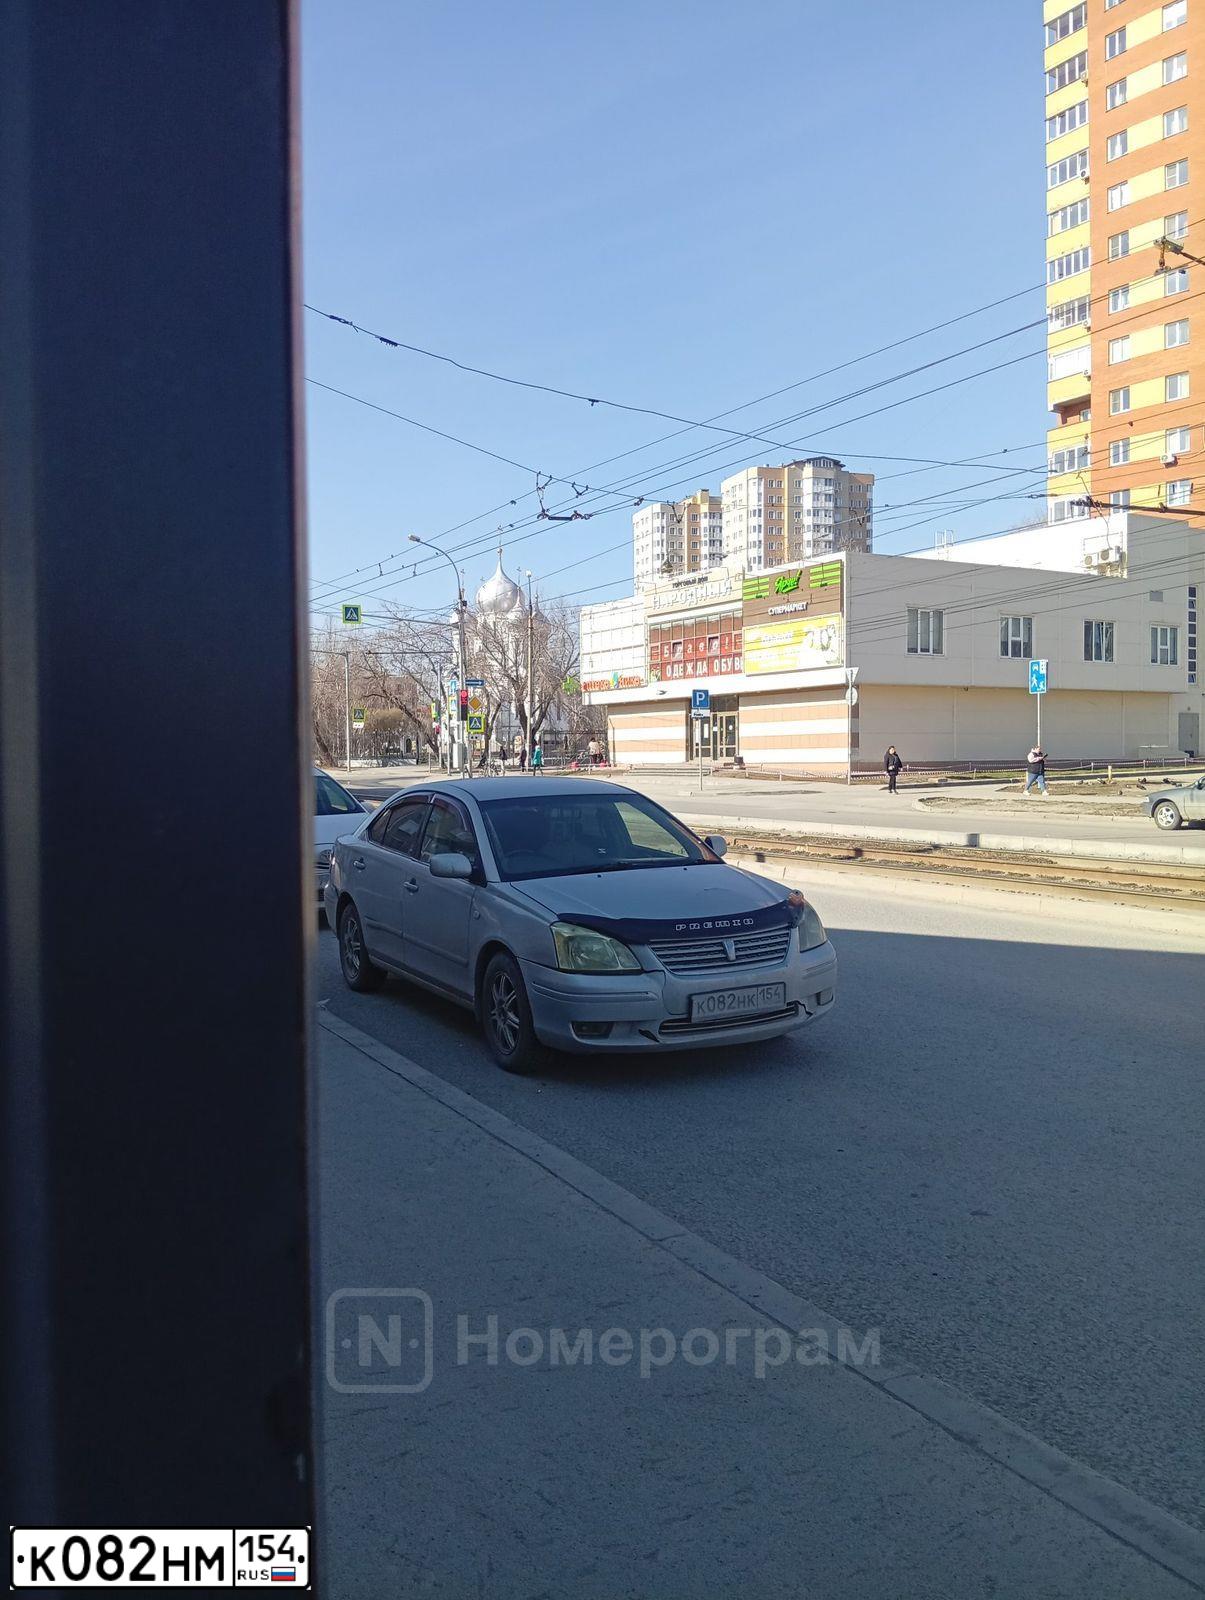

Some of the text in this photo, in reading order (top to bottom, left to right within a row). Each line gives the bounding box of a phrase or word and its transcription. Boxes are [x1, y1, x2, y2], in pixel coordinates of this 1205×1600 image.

[768, 601, 808, 616] СУПЕРМАРКЕТ
[666, 660, 708, 679] ОДЕЖДА
[675, 918, 754, 931] PREMIO
[760, 986, 781, 1001] 154
